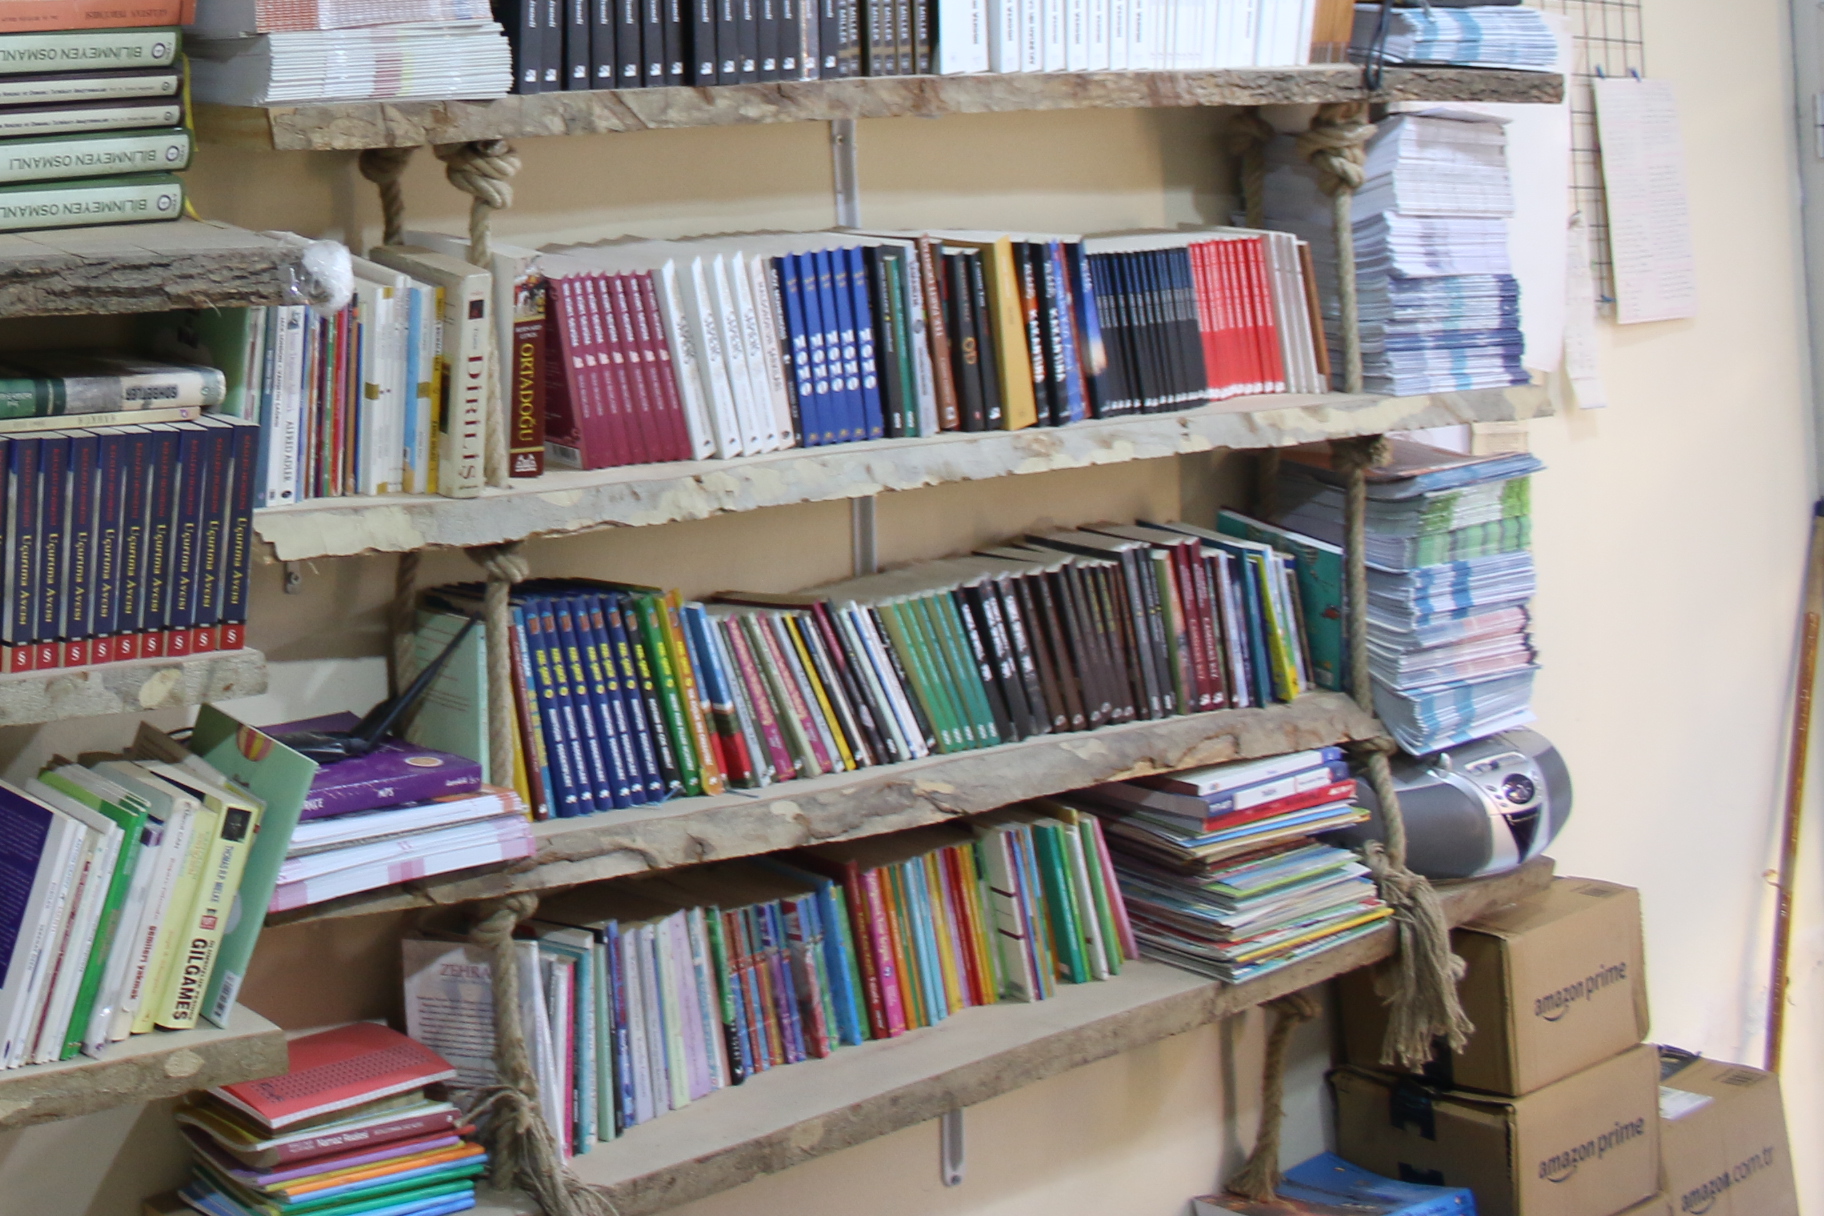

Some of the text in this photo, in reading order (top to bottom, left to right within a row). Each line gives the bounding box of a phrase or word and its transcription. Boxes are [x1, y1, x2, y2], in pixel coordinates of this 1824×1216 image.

[519, 342, 538, 442] ORTADOĞU
[1534, 960, 1628, 1017] amazon prime
[1539, 1115, 1645, 1179] amazon prime
